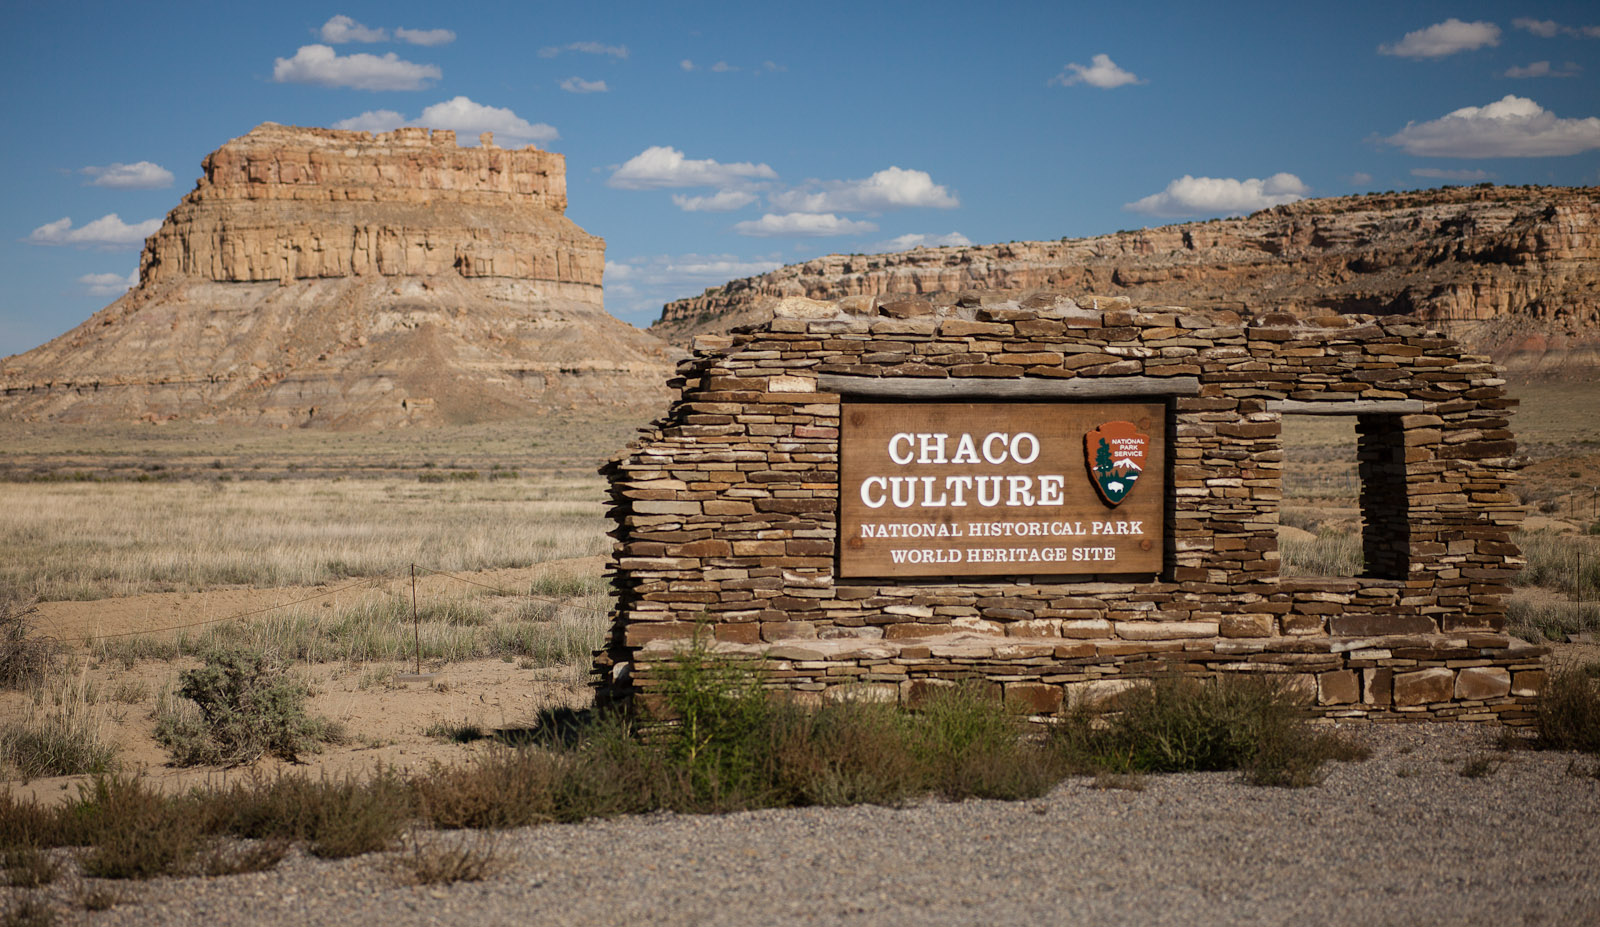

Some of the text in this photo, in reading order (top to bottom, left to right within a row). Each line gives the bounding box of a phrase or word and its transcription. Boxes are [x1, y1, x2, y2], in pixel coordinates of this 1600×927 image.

[888, 432, 1041, 465] CHACO
[860, 475, 1065, 508] CULTURE
[860, 520, 1144, 538] NATIONAL HISTORICAL PARK
[890, 547, 1116, 564] WORLD HERITAGE SITE
